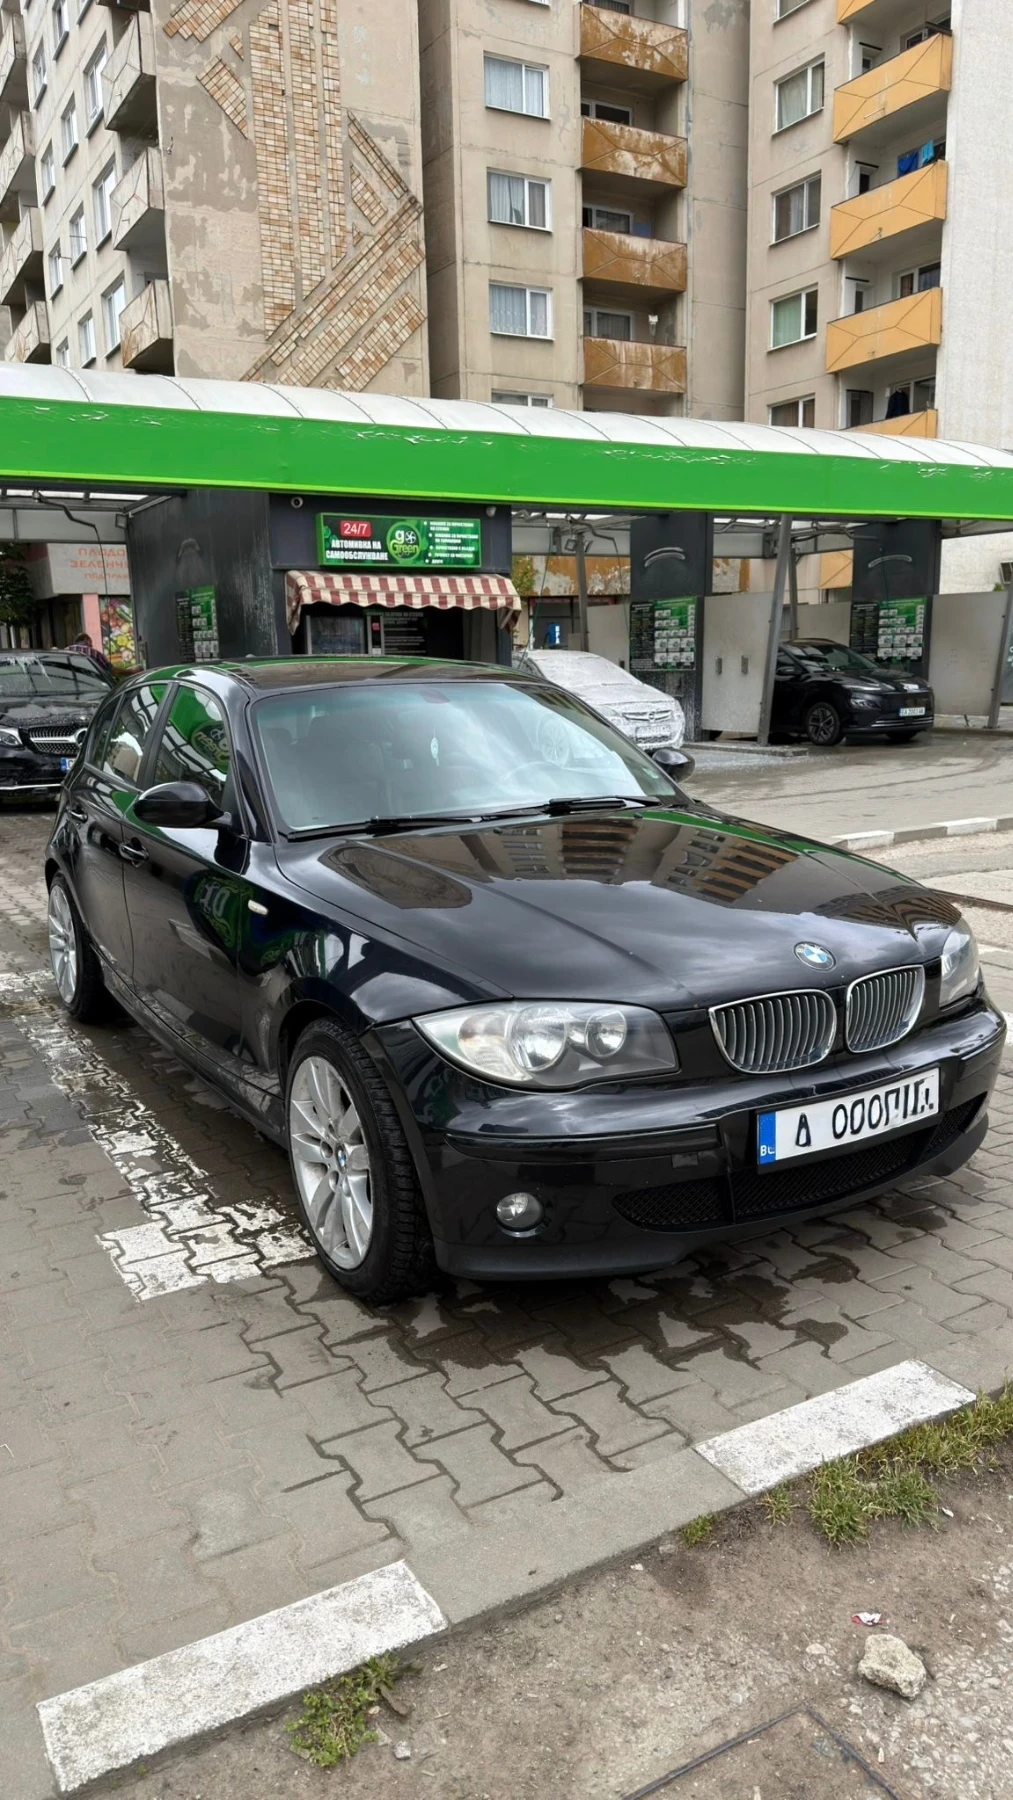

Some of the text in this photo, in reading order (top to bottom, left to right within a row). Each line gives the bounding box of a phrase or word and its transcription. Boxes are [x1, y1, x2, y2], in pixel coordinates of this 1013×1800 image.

[343, 522, 368, 535] 24/7
[331, 539, 382, 550] АВТОМИВКА НА
